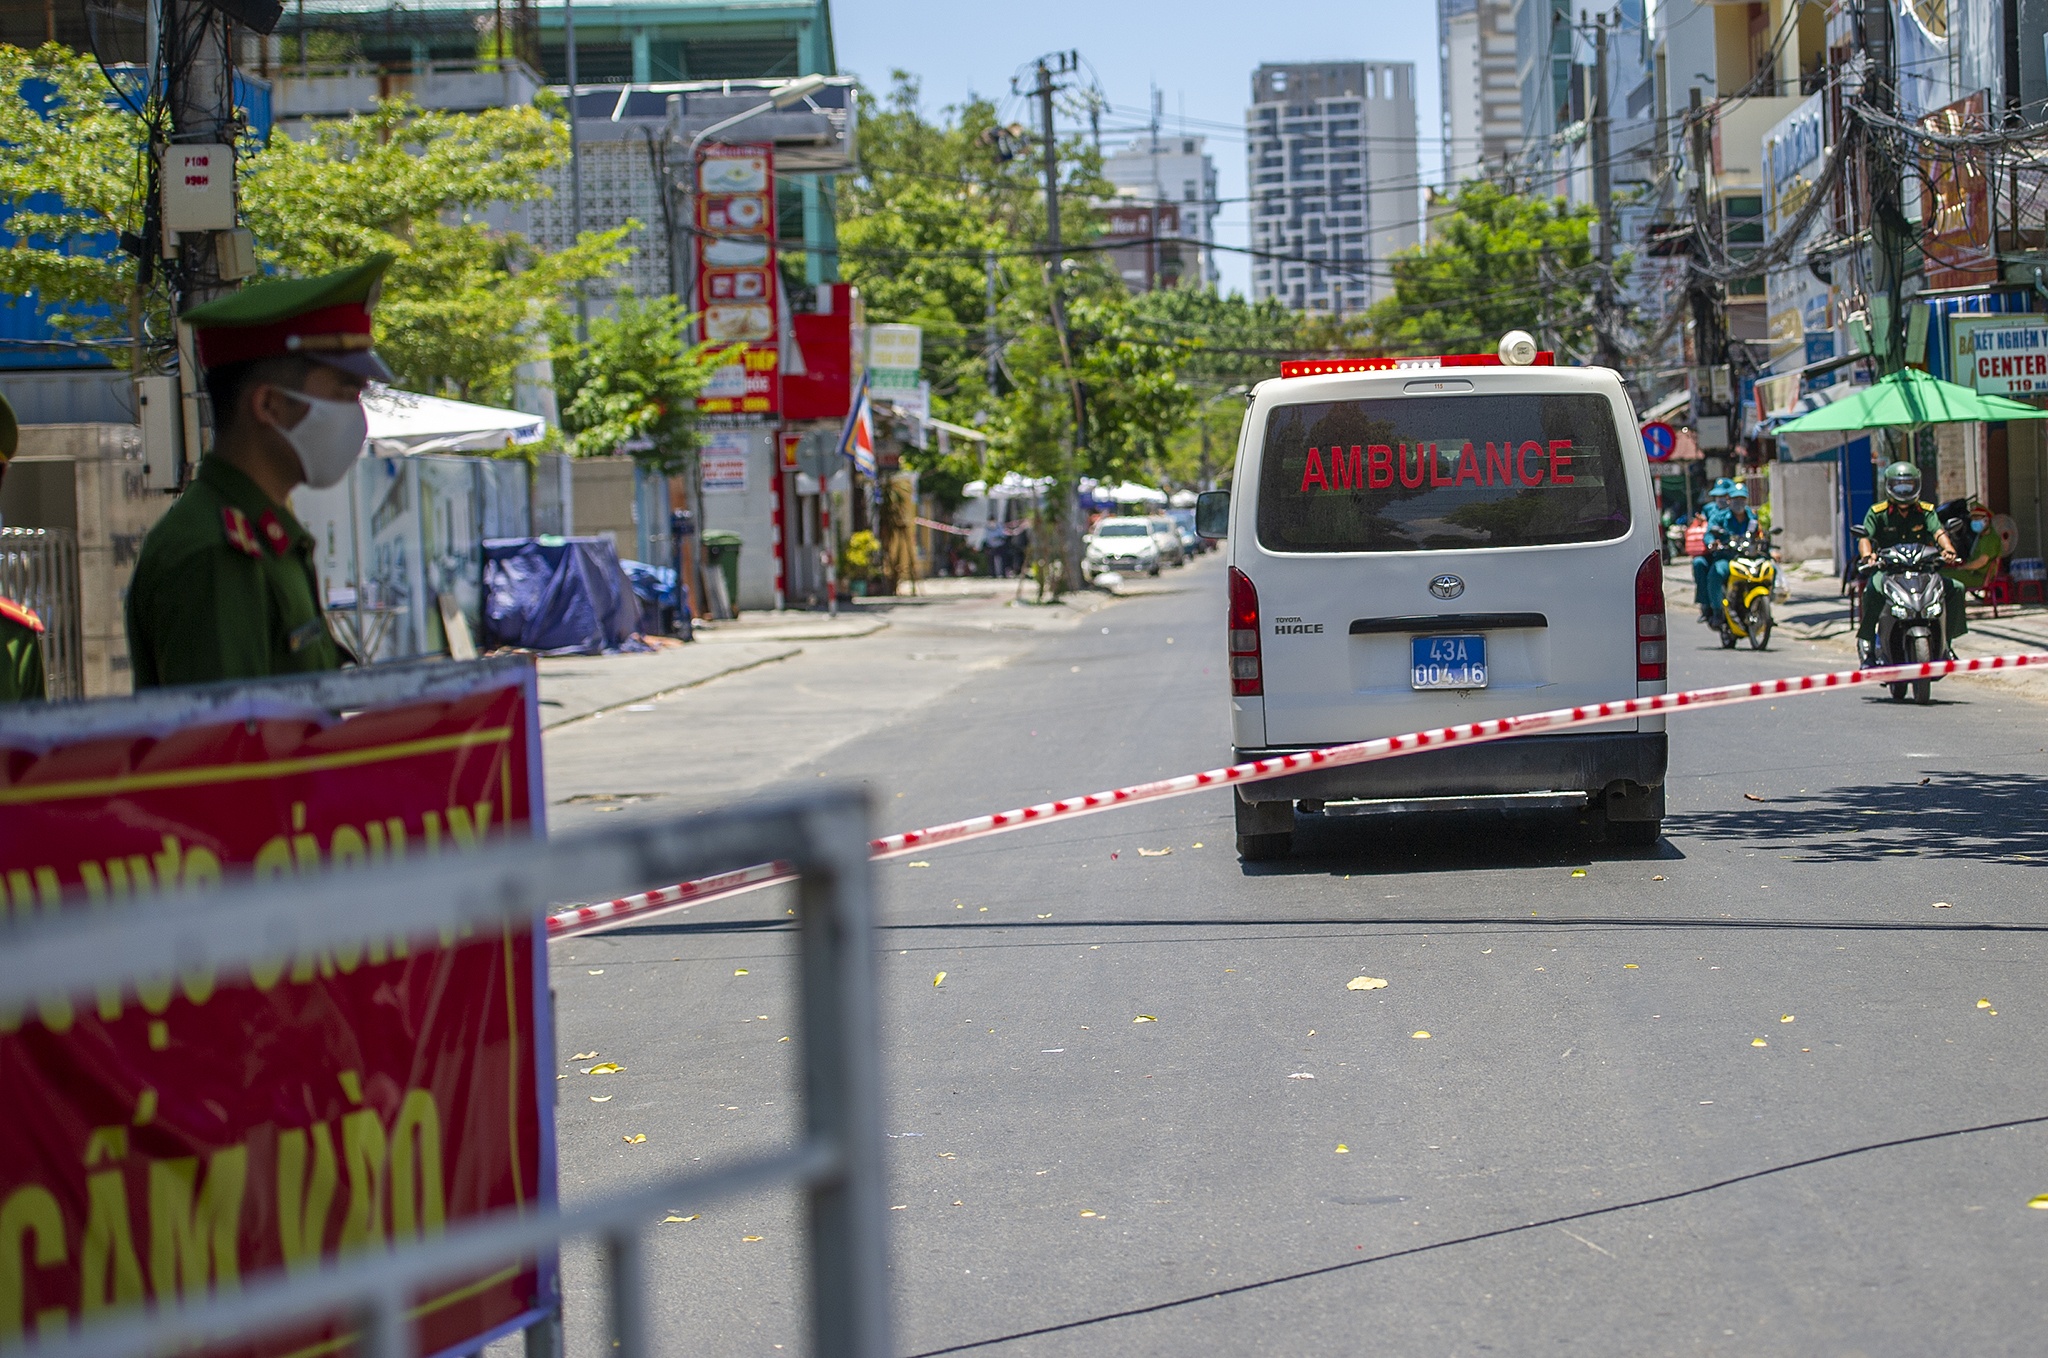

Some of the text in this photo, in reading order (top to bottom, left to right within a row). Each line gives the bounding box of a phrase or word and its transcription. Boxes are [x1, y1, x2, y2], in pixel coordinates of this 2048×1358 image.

[1997, 327, 2039, 352] NGHIỆM
[2007, 379, 2032, 392] 119
[1301, 439, 1574, 492] AMBULANCE
[1275, 624, 1324, 635] HIACE
[1429, 639, 1468, 661] 43A
[1415, 662, 1485, 686] 004.16
